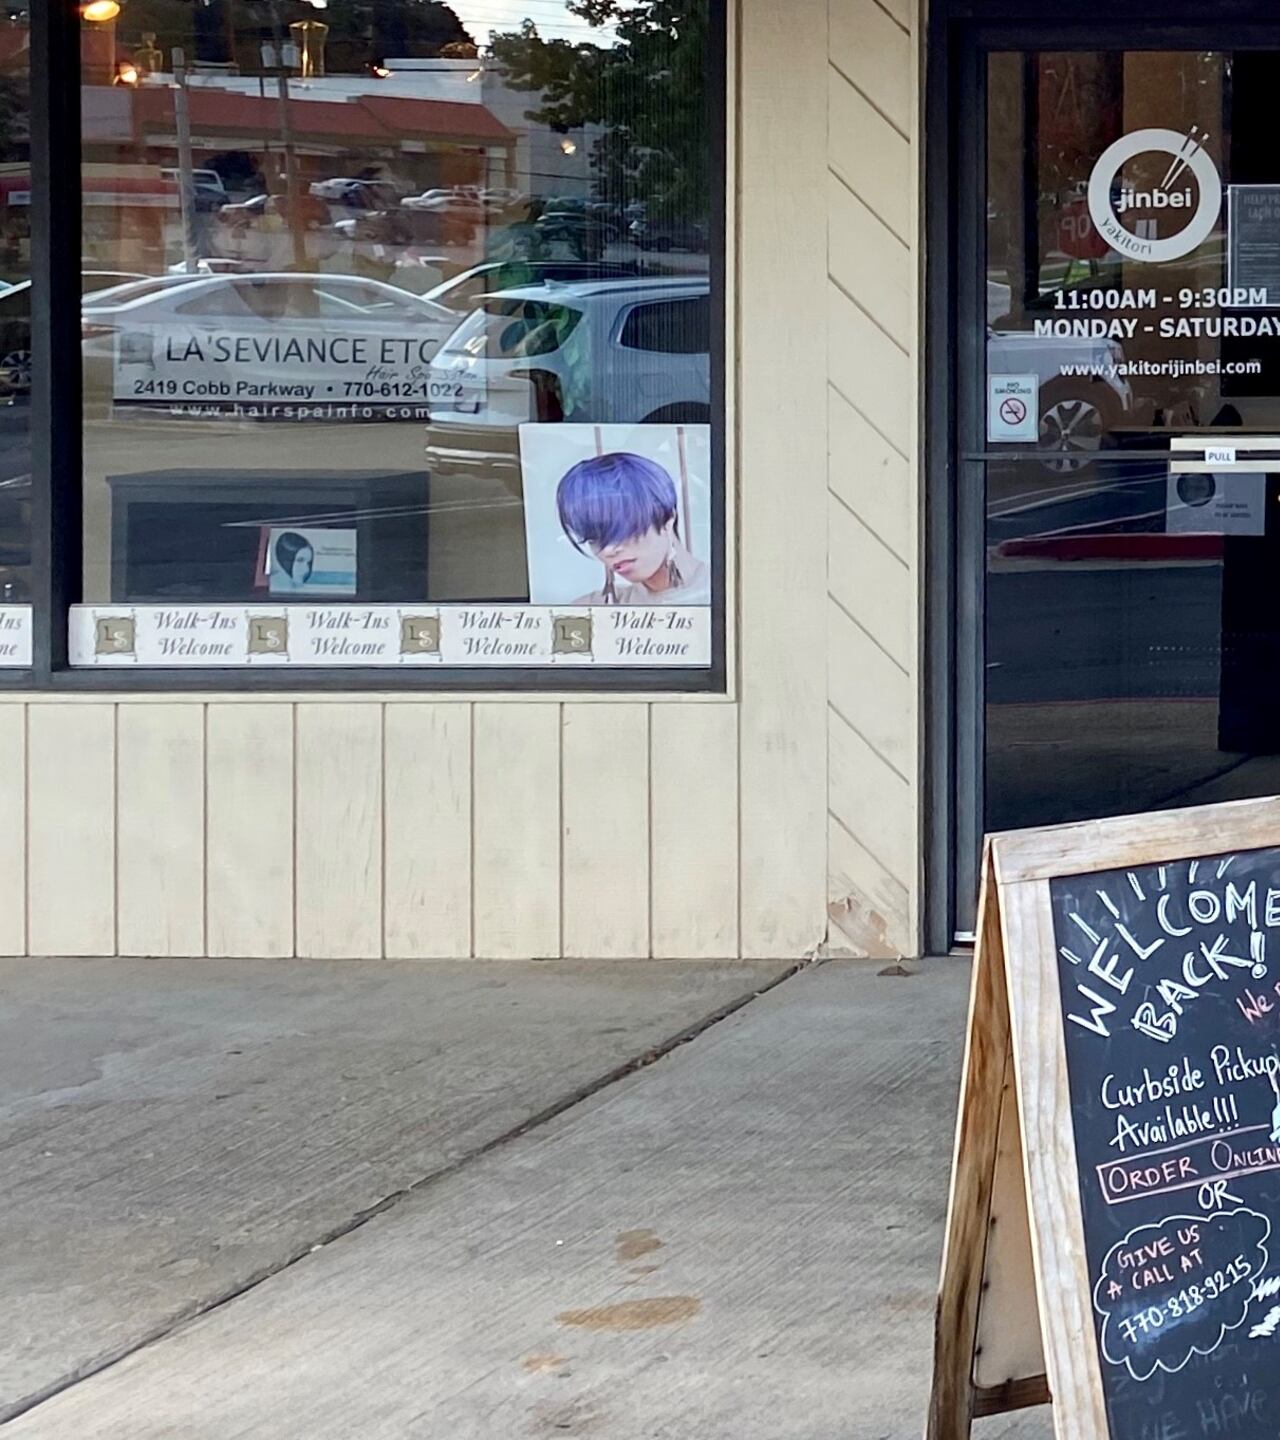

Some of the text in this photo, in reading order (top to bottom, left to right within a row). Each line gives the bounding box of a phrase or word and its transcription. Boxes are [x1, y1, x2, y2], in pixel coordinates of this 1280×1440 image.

[1117, 188, 1192, 213] jinbei
[1099, 217, 1152, 255] yakitori
[1054, 288, 1156, 310] 11:00AM
[1178, 288, 1268, 308] 9:30PM
[1033, 318, 1138, 339] MONDAY
[166, 336, 367, 364] LA'SEVIANCE
[1060, 359, 1261, 378] www.yakitorijinbei.com
[134, 380, 464, 400] 2419 Cobb Parkway 770-612-1022
[1208, 452, 1231, 462] PULL
[154, 611, 237, 630] Walk-Ins
[306, 611, 390, 630] Walk-Ins
[457, 611, 542, 630] Walk-Ins
[610, 611, 694, 630] Walk-Ins
[158, 637, 234, 656] Welcome
[311, 637, 386, 656] Welcome
[463, 637, 538, 656] Welcome
[615, 637, 690, 656] Welcome
[1130, 930, 1267, 1043] BACK!
[1236, 988, 1275, 1023] We
[1101, 1044, 1280, 1109] Curbside Pickup
[1109, 1094, 1240, 1152] Available!!!
[1107, 1156, 1198, 1193] ORDER
[1198, 1179, 1244, 1210] OR
[1117, 1224, 1200, 1270] GIVE US
[1107, 1248, 1204, 1300] A CALL AT
